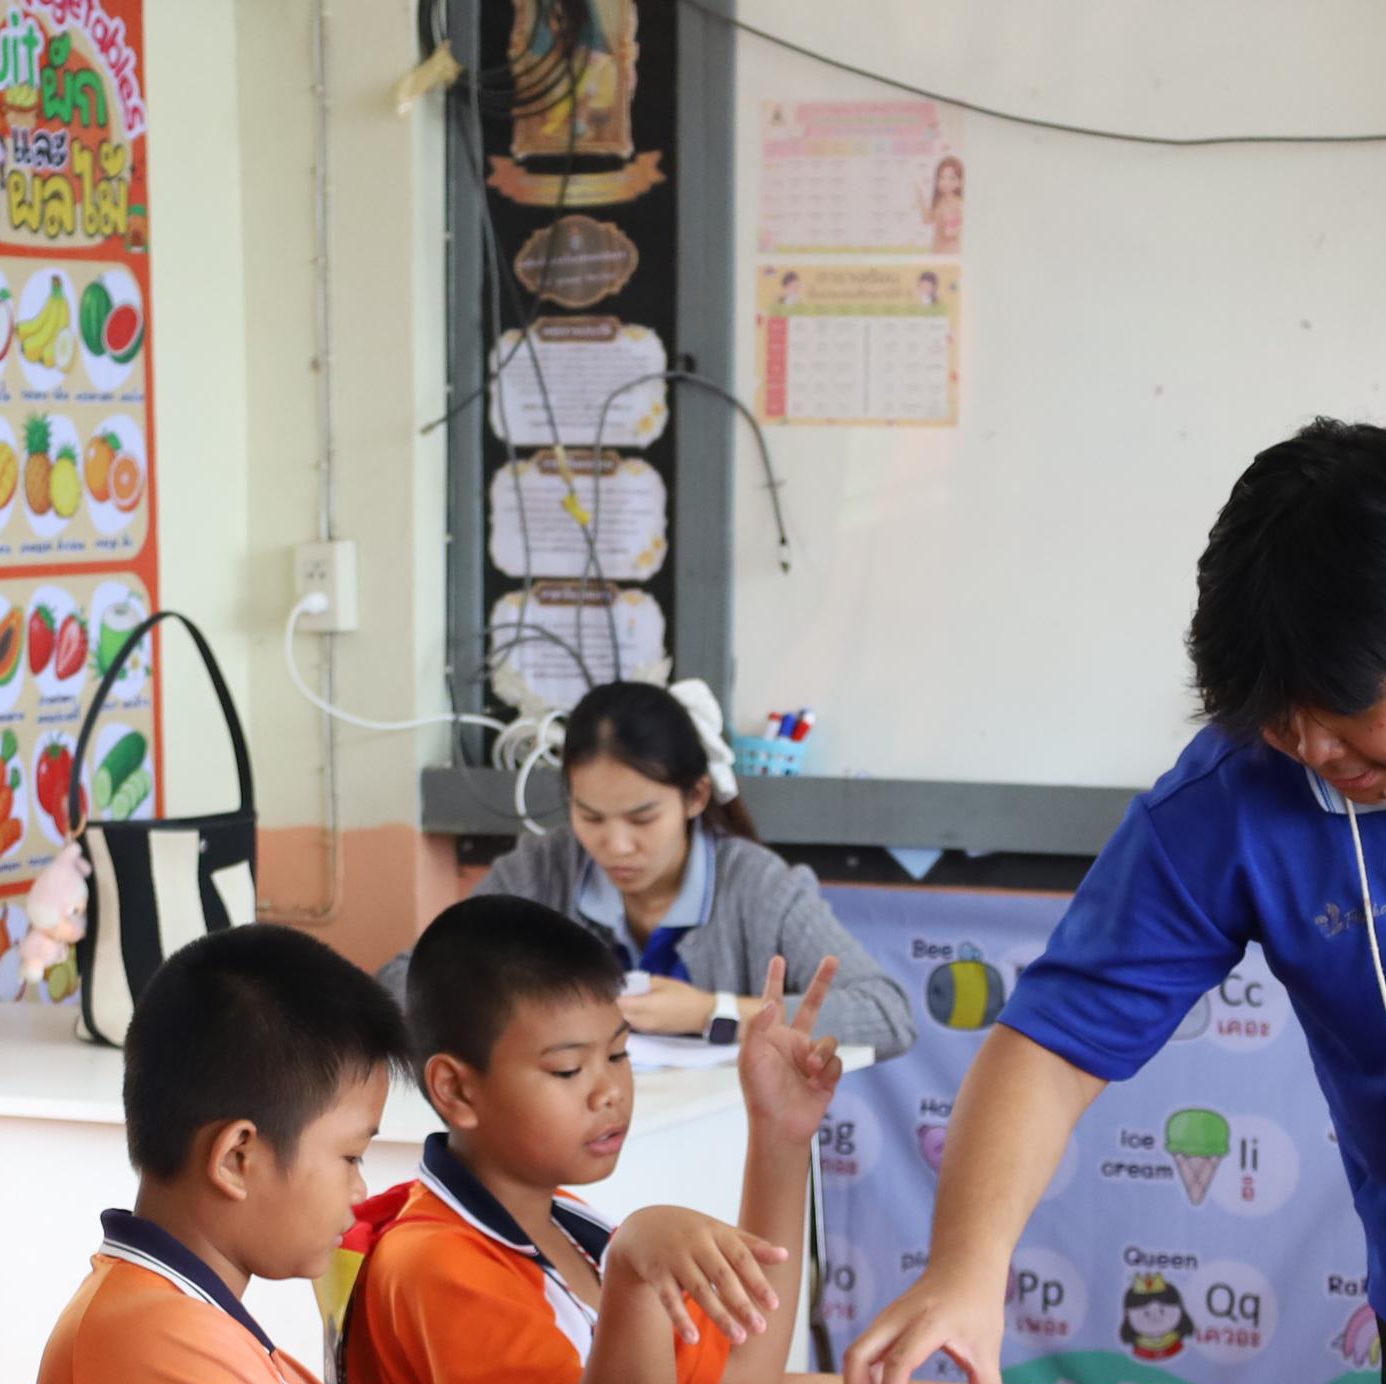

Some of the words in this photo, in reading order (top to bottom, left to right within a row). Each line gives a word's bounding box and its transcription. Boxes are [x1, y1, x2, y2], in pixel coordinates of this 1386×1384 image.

[41, 31, 108, 127] ผัก
[8, 138, 129, 239] ผลไม้
[912, 940, 953, 960] Bee
[1219, 973, 1264, 1008] Cc
[1101, 1160, 1174, 1179] cream
[1124, 1246, 1198, 1271] Queen
[1017, 1271, 1064, 1313] Pp
[1205, 1283, 1261, 1328] Qq
